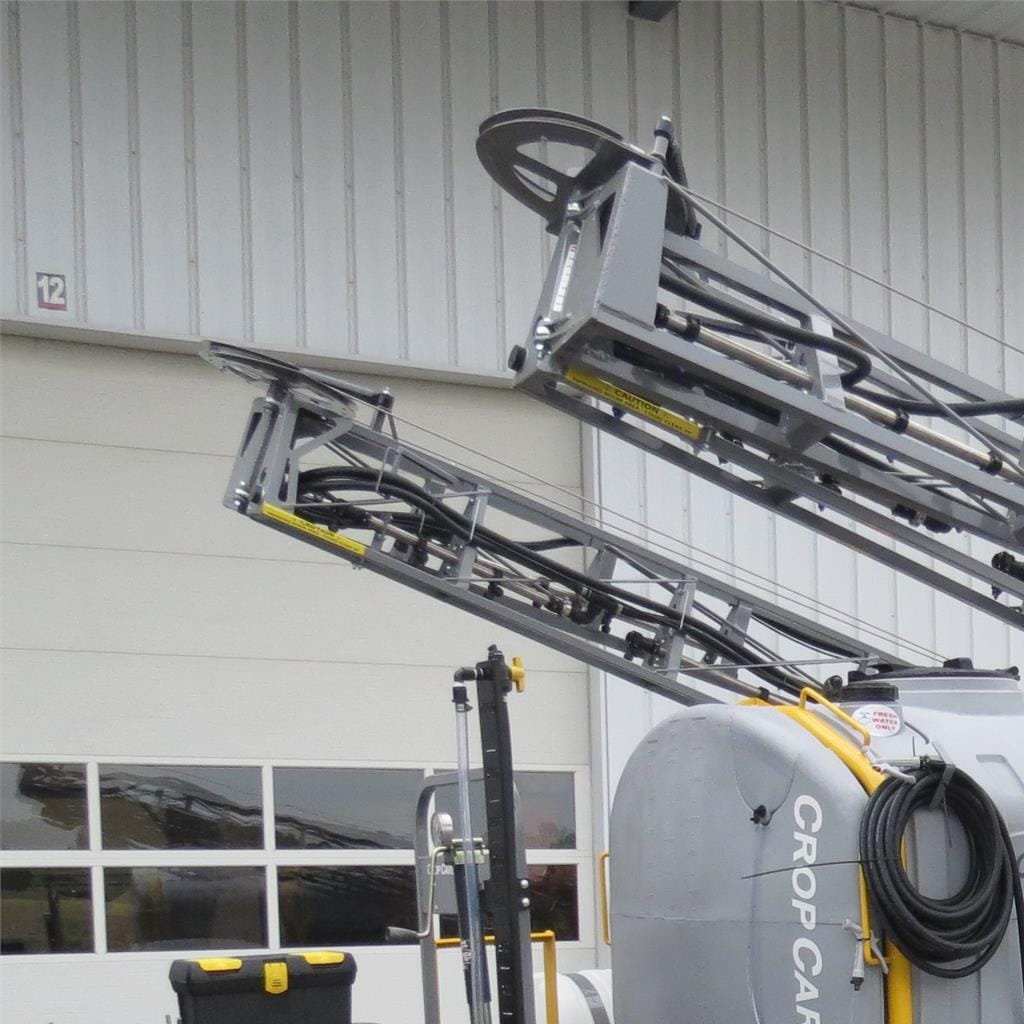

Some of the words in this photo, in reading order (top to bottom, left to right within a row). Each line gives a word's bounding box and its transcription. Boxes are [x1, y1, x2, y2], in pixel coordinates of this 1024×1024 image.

[38, 275, 66, 304] 12
[615, 390, 660, 414] CAUTION
[792, 794, 823, 931] CROP
